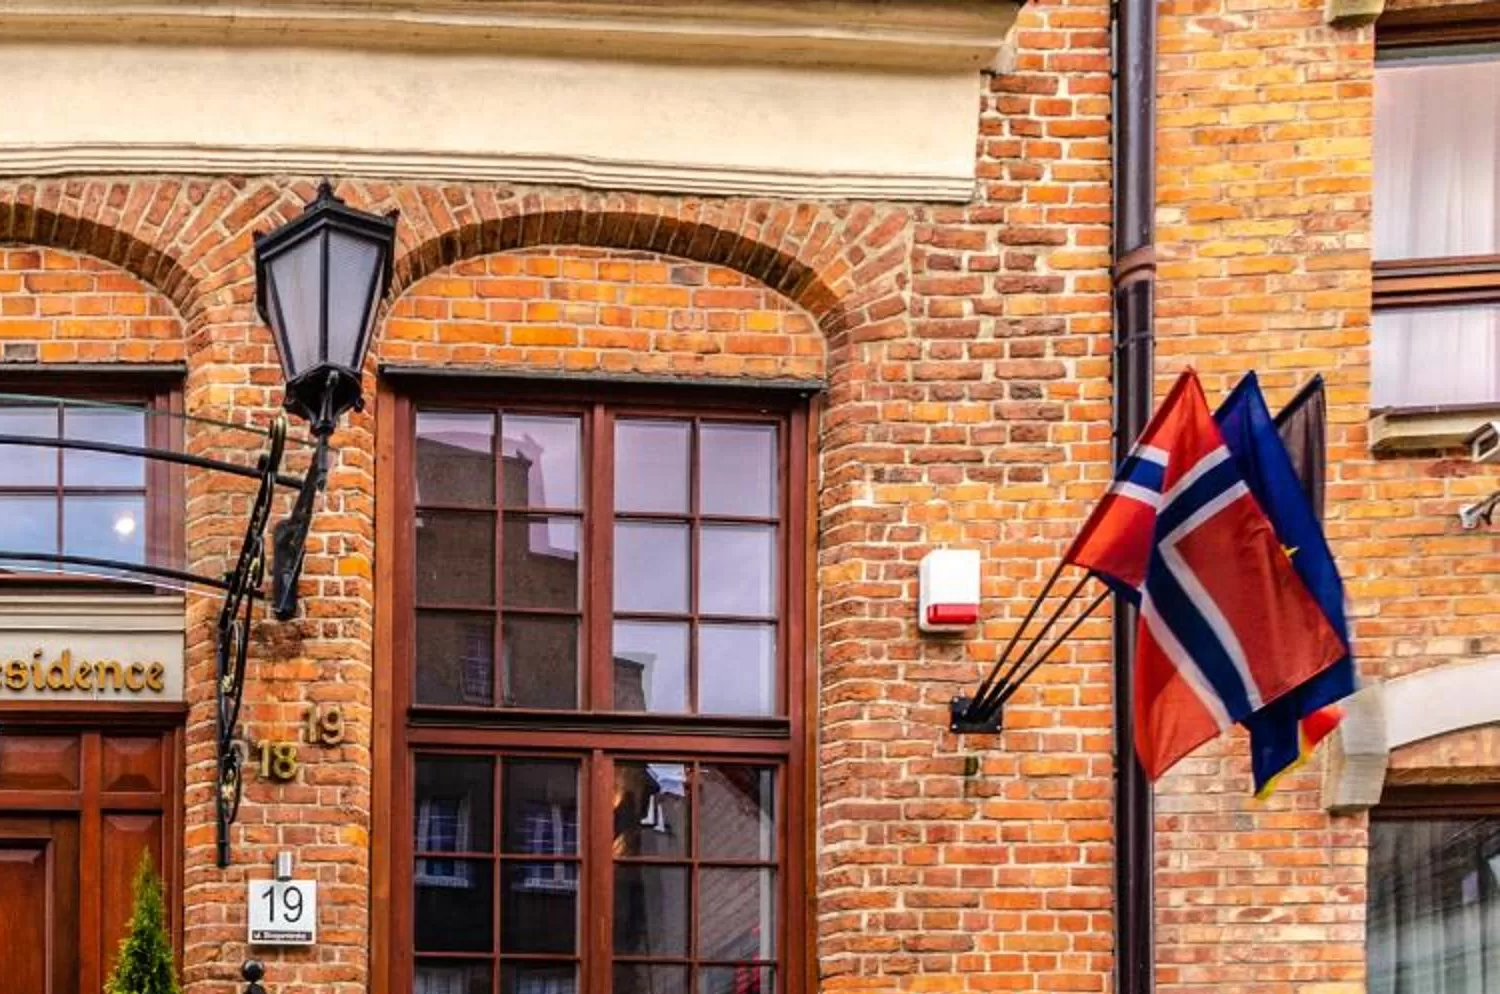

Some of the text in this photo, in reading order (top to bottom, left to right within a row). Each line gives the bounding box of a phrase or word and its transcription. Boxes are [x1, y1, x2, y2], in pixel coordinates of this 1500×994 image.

[304, 704, 344, 744] 19
[257, 741, 297, 779] 18
[261, 885, 303, 923] 19
